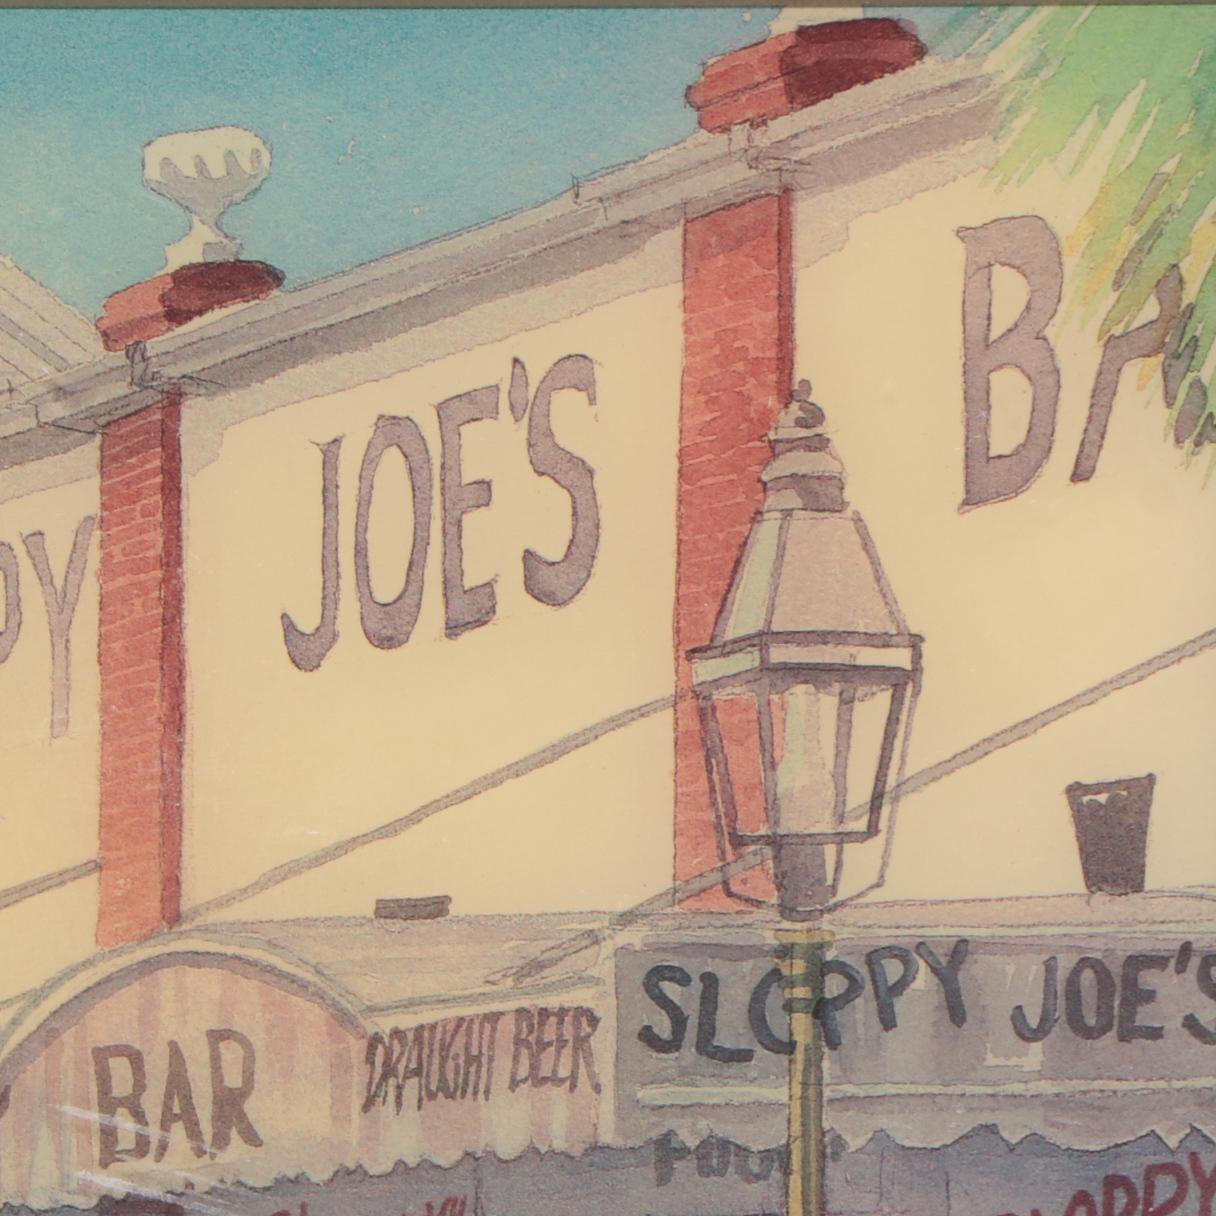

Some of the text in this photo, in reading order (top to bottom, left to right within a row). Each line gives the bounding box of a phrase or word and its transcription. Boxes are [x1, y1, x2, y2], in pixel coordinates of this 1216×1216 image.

[283, 353, 602, 672] JOE'S
[92, 1028, 264, 1170] BAR
[361, 1005, 602, 1116] DRAUGHT BEER
